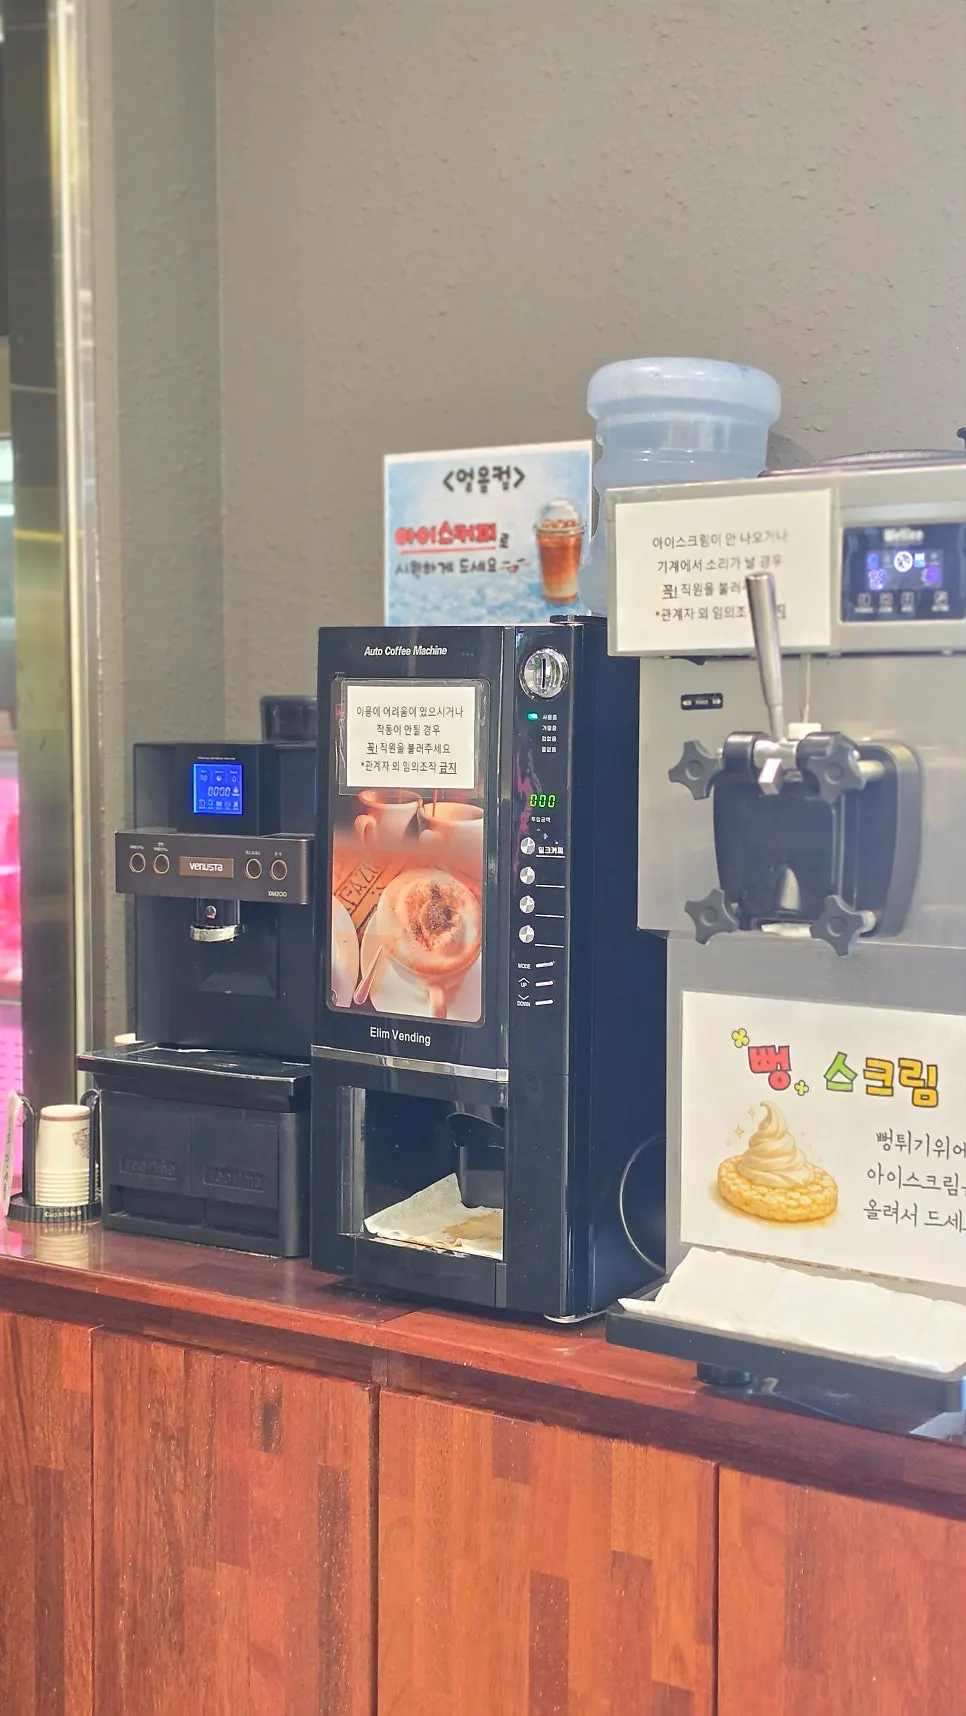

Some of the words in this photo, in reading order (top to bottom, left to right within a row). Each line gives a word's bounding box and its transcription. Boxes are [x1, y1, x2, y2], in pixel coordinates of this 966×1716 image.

[652, 533, 721, 550] 아이스크림이
[725, 532, 737, 547] 안
[740, 529, 788, 545] 나오거나
[458, 556, 498, 574] 드세요
[657, 557, 702, 574] 기계에서
[706, 556, 741, 571] 소리가
[662, 584, 677, 600] 꼭!
[680, 581, 714, 597] 직원을
[698, 606, 709, 621] 외
[712, 604, 747, 621] 임의조
[364, 646, 383, 656] Auto
[384, 645, 411, 656] Coffee
[413, 645, 448, 656] Machine
[356, 706, 381, 718] 이용에
[382, 706, 417, 718] 어려움이
[419, 706, 464, 718] 있으시거나
[376, 724, 402, 736] 작동이
[403, 724, 421, 736] 안될
[423, 724, 441, 736] 경우
[366, 742, 378, 755] 꼭!
[380, 742, 405, 755] 직원을
[407, 743, 451, 755] 불러주세요
[391, 760, 400, 772] 외
[402, 760, 437, 772] 임의조작
[439, 761, 457, 775] 금지
[530, 794, 556, 808] 000
[370, 1026, 390, 1039] Elim
[391, 1029, 431, 1047] Vending
[747, 1044, 792, 1091] 뻥
[823, 1051, 939, 1108] 스크림
[867, 1162, 966, 1197] 아이스크림
[863, 1199, 918, 1228] 올려서
[924, 1208, 966, 1234] 드세
